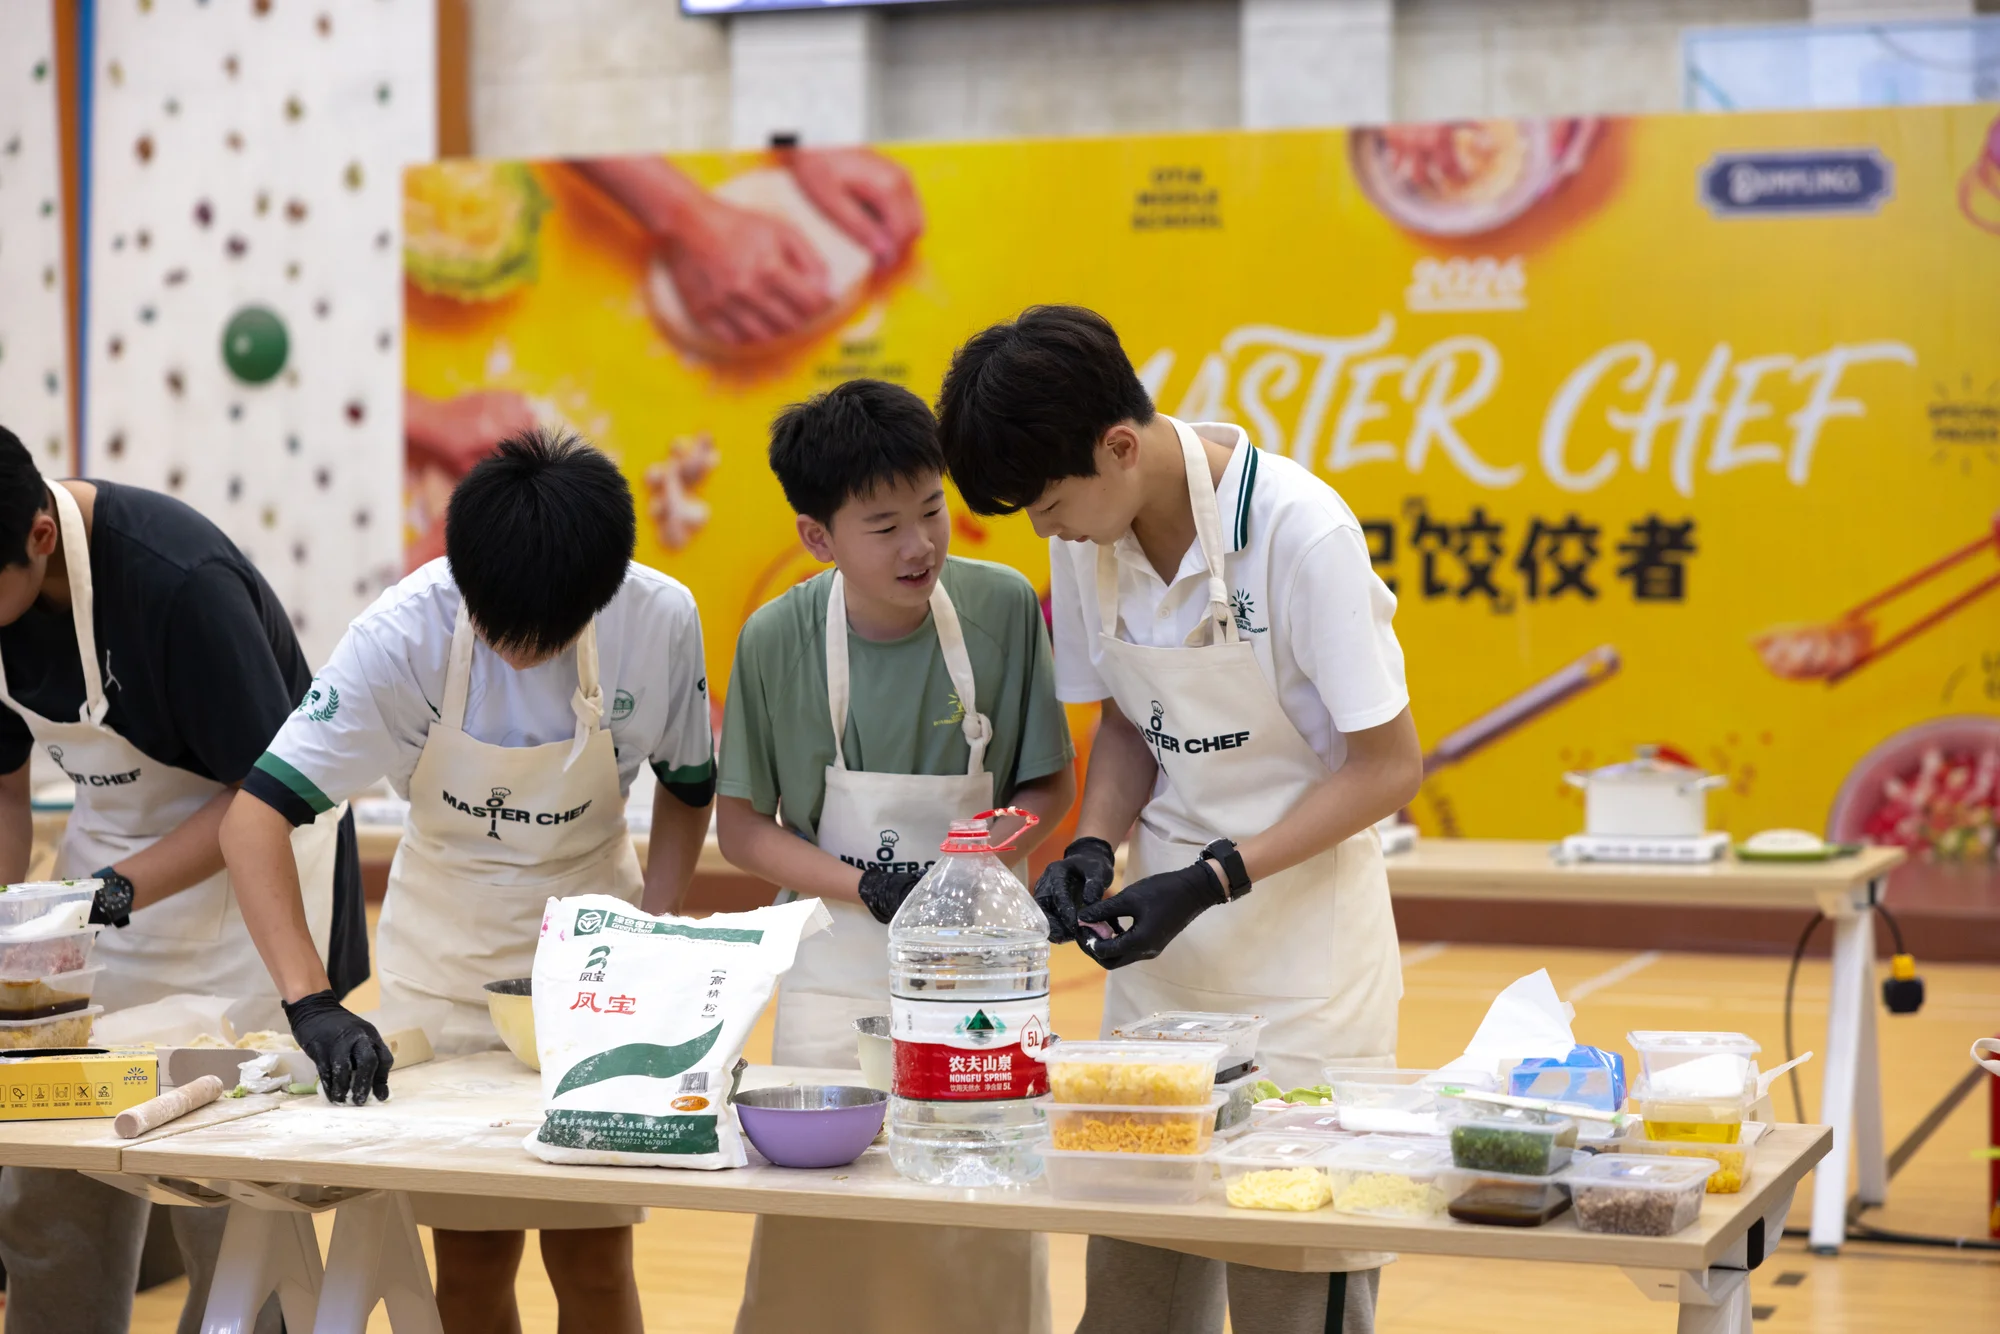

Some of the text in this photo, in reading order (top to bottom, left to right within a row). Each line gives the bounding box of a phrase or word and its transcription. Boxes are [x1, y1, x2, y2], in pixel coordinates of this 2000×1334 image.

[1404, 256, 1527, 300] 2026
[1137, 311, 1918, 499] ASTER CHEF
[1135, 720, 1250, 754] STER CHEF
[89, 768, 141, 787] CHEF
[443, 789, 593, 825] MASTER CHEF
[579, 970, 606, 983] 凤宝
[569, 991, 637, 1015] 凤宝
[1027, 1030, 1040, 1048] 5L
[949, 1055, 1013, 1072] 农夫山泉
[949, 1072, 1012, 1083] NONGFU SPRING
